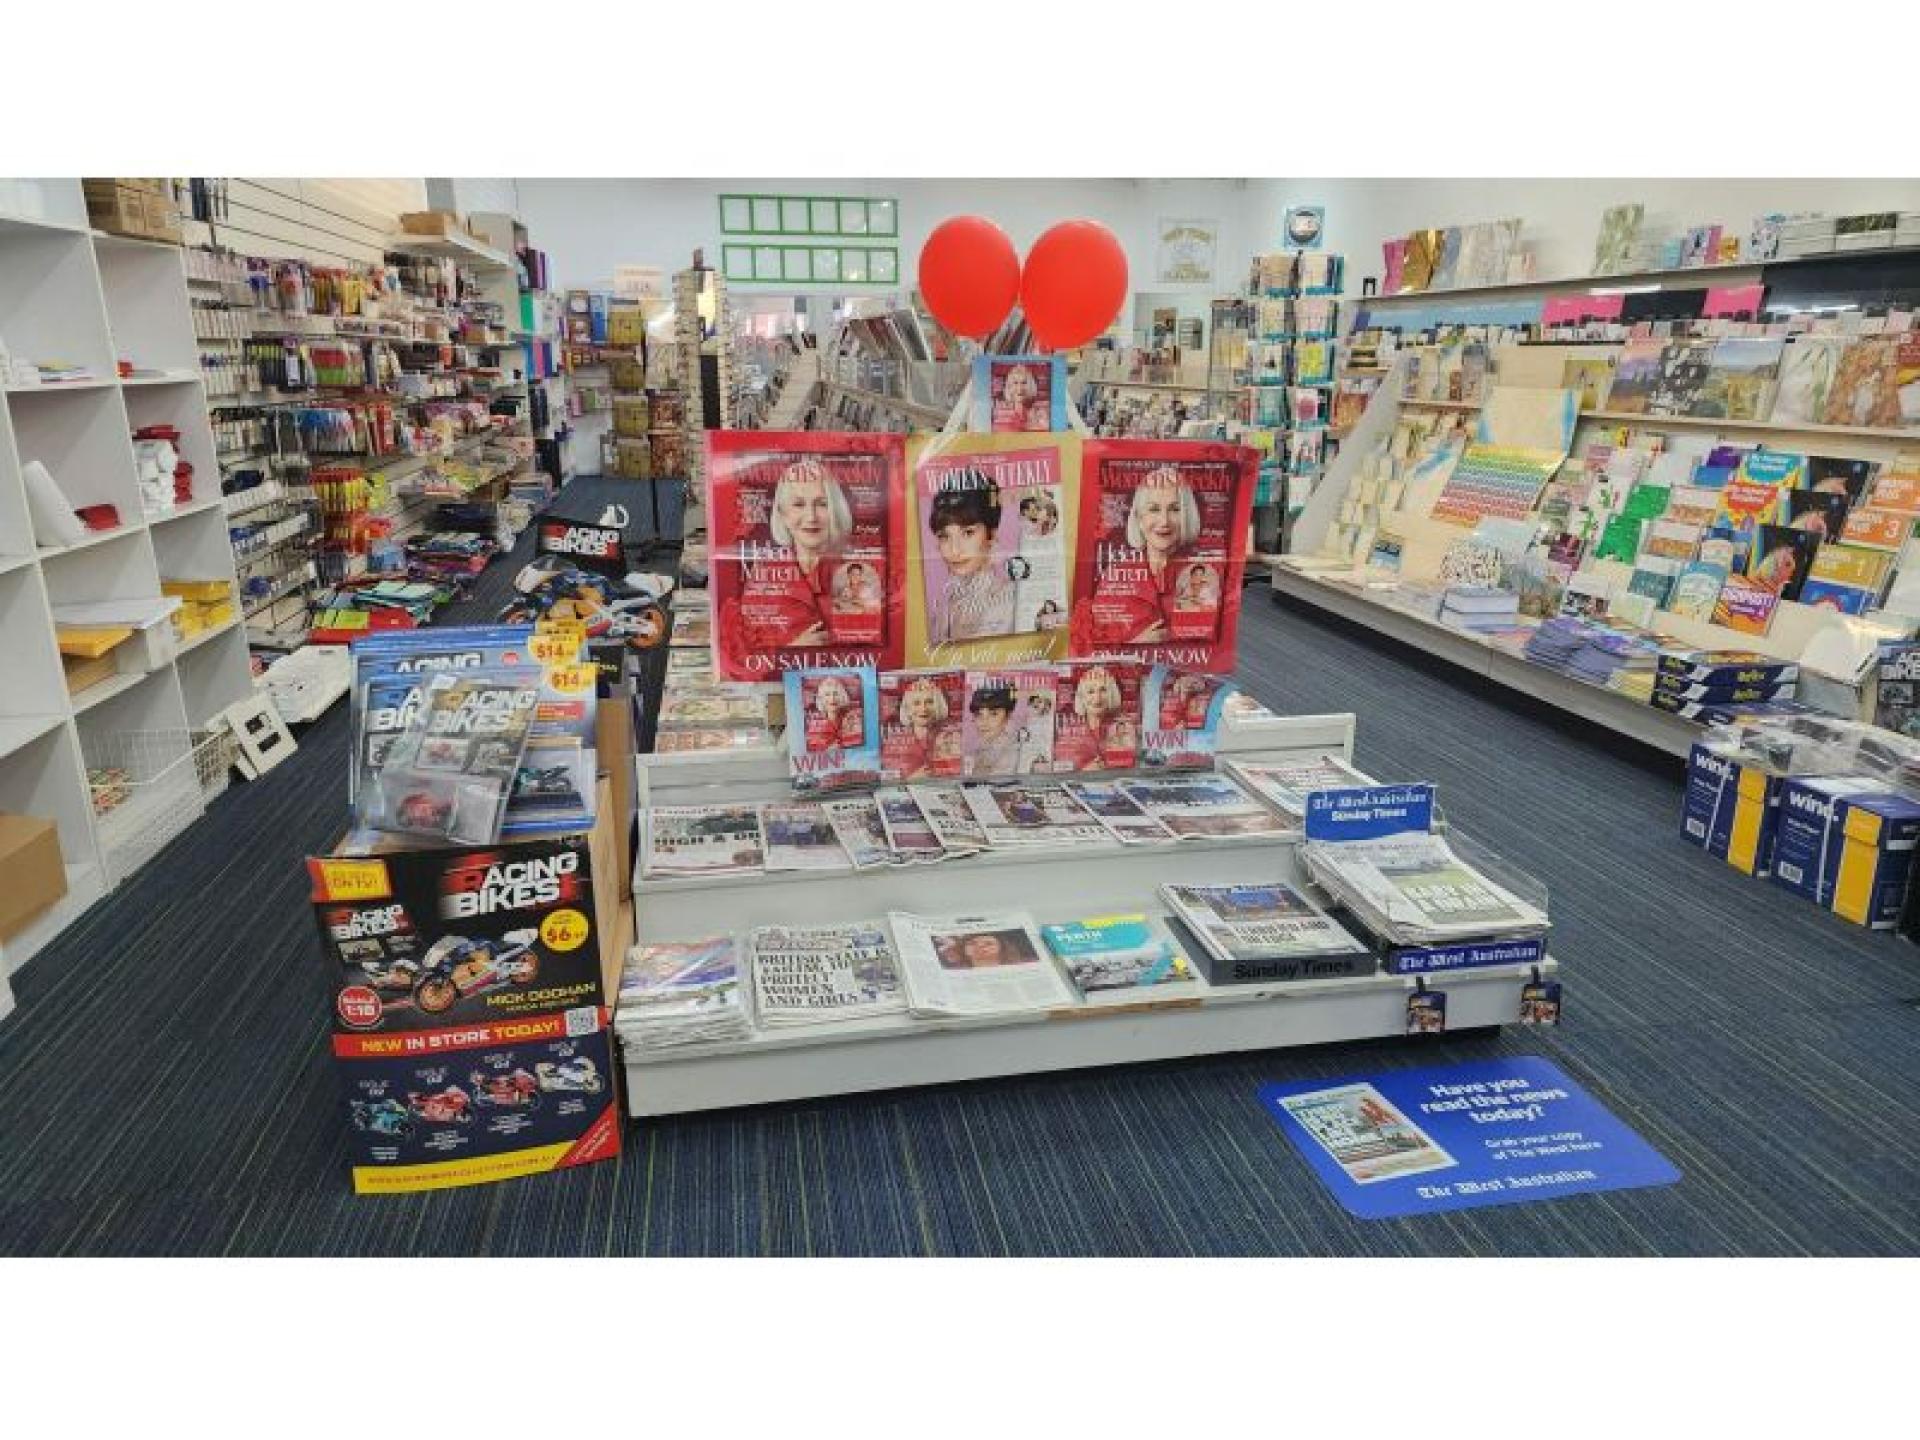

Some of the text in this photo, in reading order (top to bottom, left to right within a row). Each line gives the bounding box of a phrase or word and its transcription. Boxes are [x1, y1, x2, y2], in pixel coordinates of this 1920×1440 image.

[995, 459, 1052, 486] WEEKLY
[740, 540, 795, 562] Helen
[1096, 542, 1145, 562] Helen
[740, 563, 803, 583] Mirren
[745, 652, 775, 672] ON
[1374, 808, 1408, 819] Times
[453, 880, 563, 919] BIKES
[1398, 944, 1538, 971] The West Australian
[1234, 958, 1354, 980] Sunday Times
[361, 1020, 559, 1054] NEW IN STORE TODAY!
[1430, 1078, 1530, 1098] Have you
[1420, 1087, 1569, 1115] read the news
[1469, 1104, 1546, 1125] today?
[1484, 1130, 1584, 1150] Grab your copy
[1492, 1140, 1603, 1161] of The West here
[1416, 1167, 1599, 1200] The West Australian
